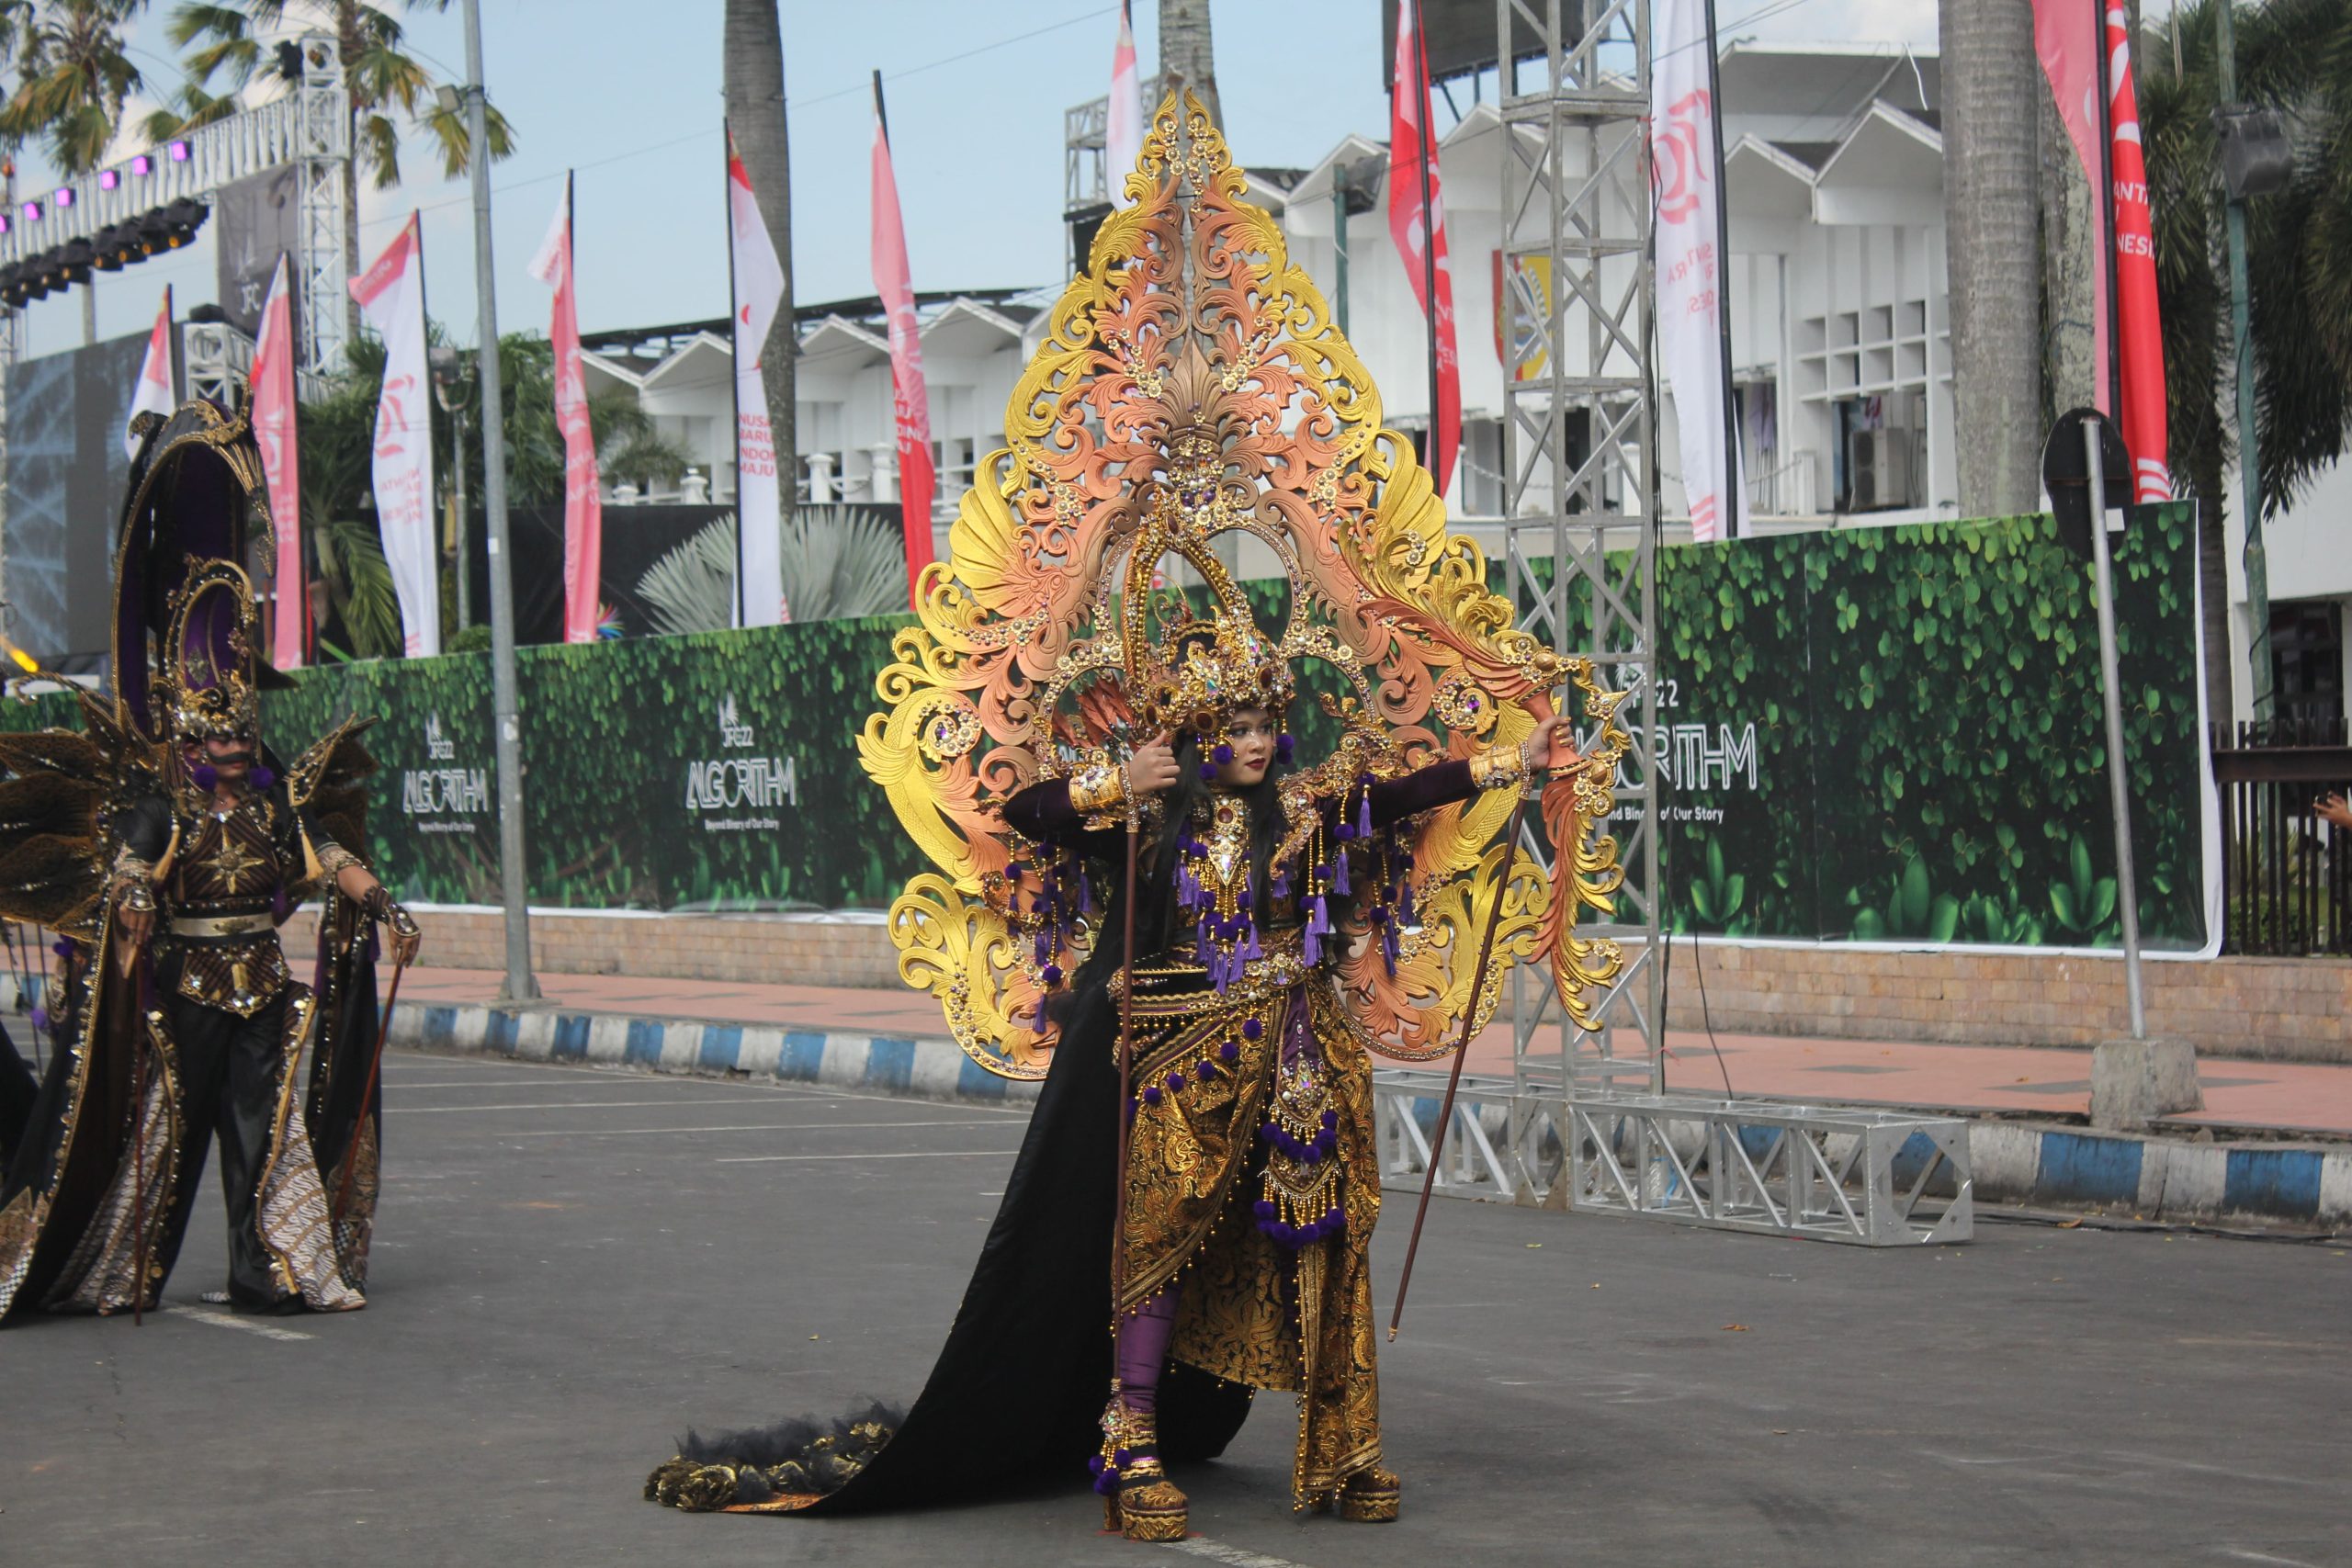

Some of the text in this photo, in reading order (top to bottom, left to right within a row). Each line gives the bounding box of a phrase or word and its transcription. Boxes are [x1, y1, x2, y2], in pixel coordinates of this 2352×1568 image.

[402, 769, 489, 814] ALGORITHM
[685, 756, 797, 808] ALGORITHM
[1695, 806, 1724, 825] Story
